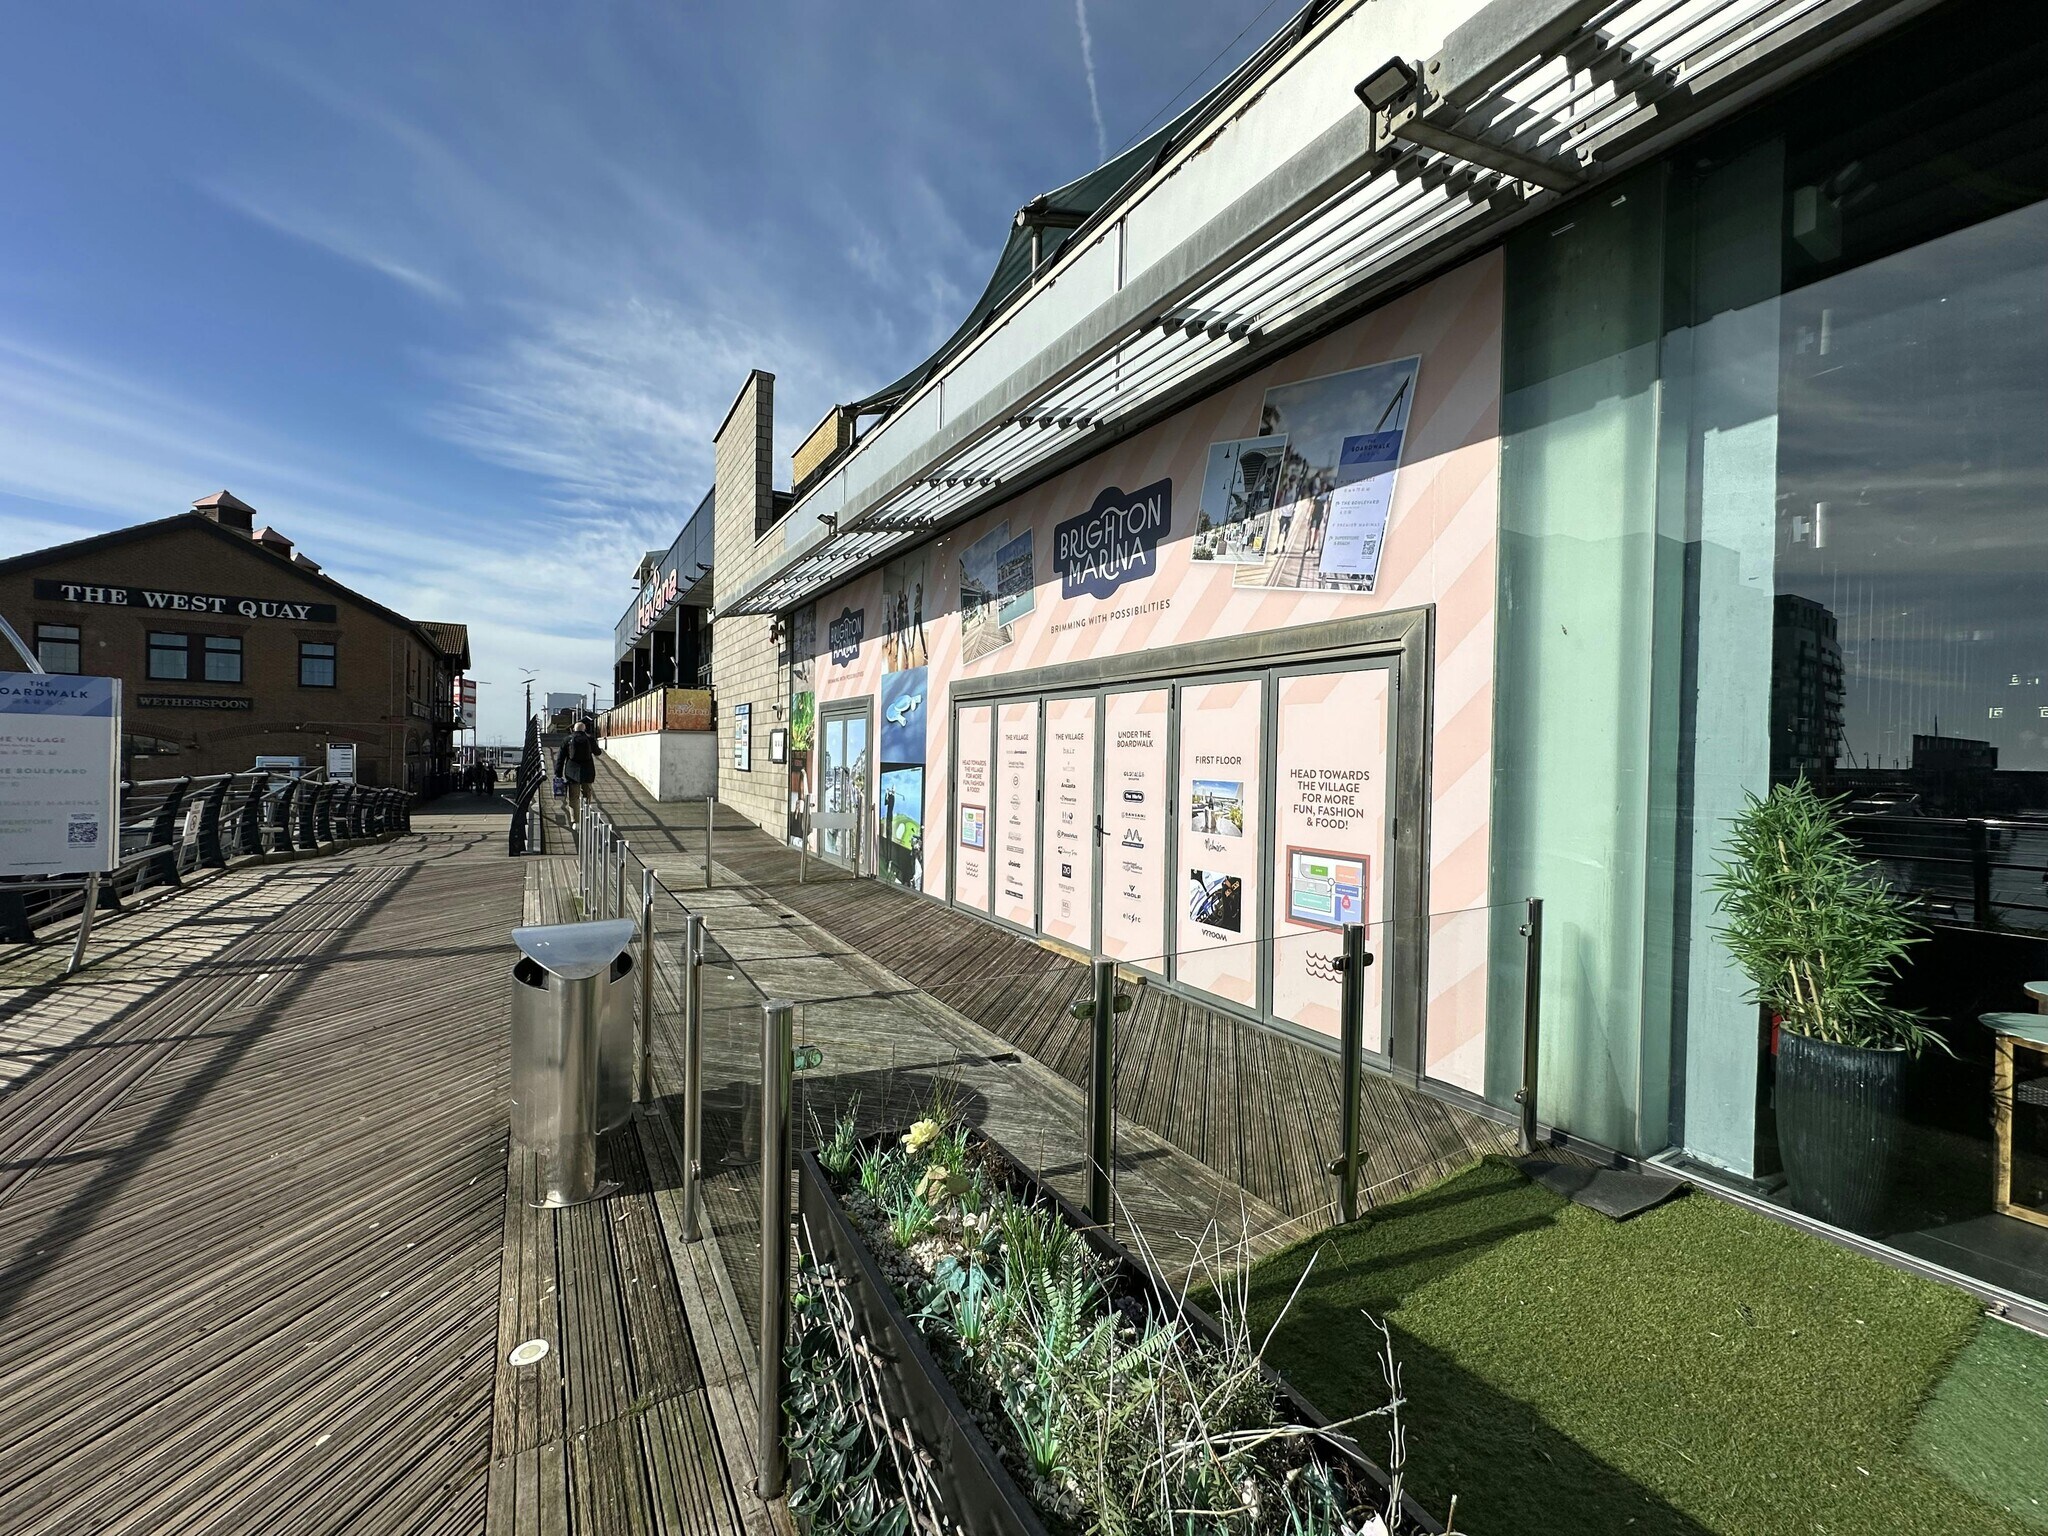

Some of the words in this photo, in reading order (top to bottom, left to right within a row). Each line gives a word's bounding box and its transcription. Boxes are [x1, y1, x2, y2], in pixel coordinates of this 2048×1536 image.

[1351, 443, 1391, 453] BOARDWALK
[1060, 494, 1162, 560] BRIGHTON
[1068, 537, 1147, 587] MARINA
[61, 584, 128, 606] THE
[142, 591, 227, 614] WEST
[238, 600, 312, 621] QUAY
[638, 565, 678, 634] Havana
[1051, 618, 1086, 634] BRIMMING
[1088, 614, 1108, 626] WITH
[1110, 599, 1171, 620] POSSIBILITIES
[30, 680, 50, 688] THE
[0, 687, 88, 699] OARDWALK
[139, 696, 249, 709] WETHERSPOON
[1013, 733, 1029, 741] VILLAGE
[1116, 740, 1154, 748] BOARDWALK
[1195, 755, 1214, 765] FIRST
[1215, 756, 1242, 766] FLOOR
[16, 767, 87, 775] BOULEVARD
[1290, 769, 1317, 779] HEAD
[1319, 769, 1370, 781] TOWARDS
[1298, 780, 1316, 791] THE
[1317, 781, 1360, 793] VILLAGE
[1302, 793, 1322, 803] FOR
[1324, 794, 1355, 806] MORE
[1293, 804, 1316, 816] FUN,
[1318, 805, 1364, 818] FASHION
[1306, 817, 1313, 827] &
[1315, 818, 1348, 830] FOOD!
